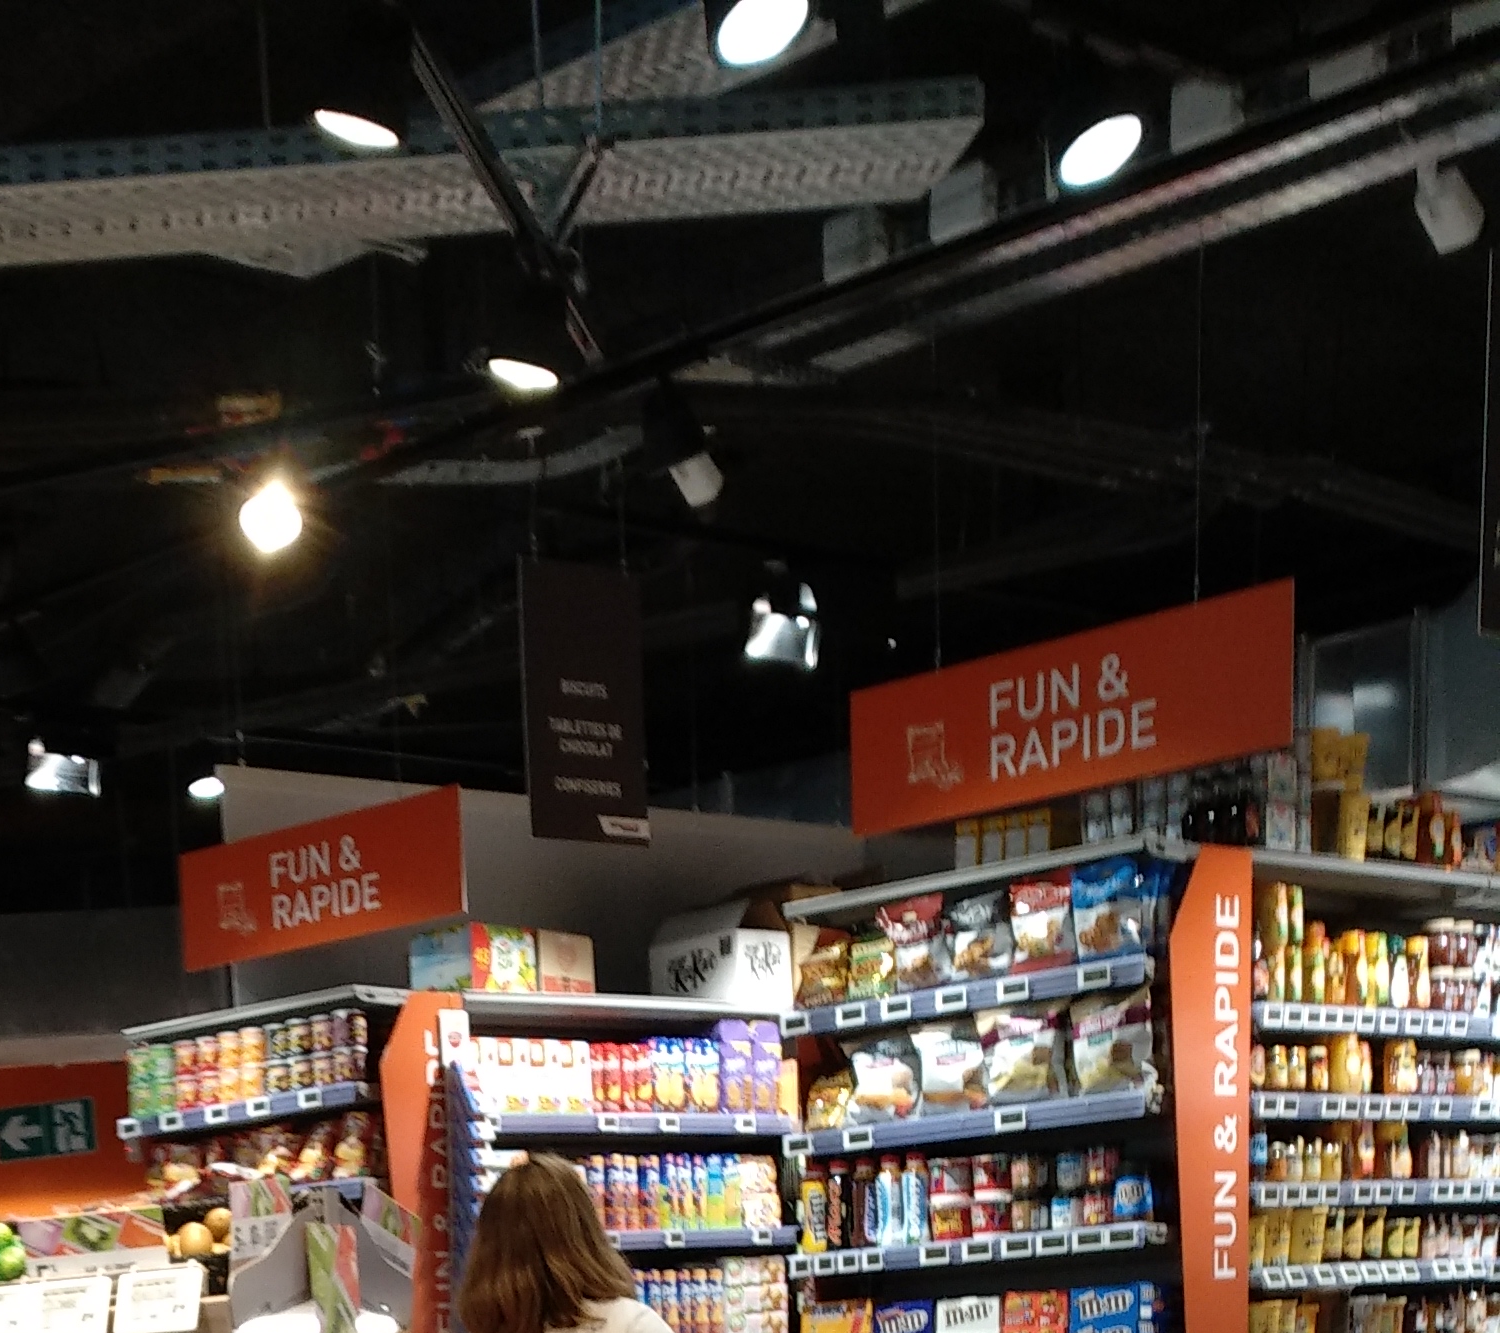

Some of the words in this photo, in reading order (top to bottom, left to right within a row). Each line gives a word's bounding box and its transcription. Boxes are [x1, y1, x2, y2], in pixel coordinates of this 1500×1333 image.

[988, 661, 1081, 729] FUN
[1096, 652, 1129, 701] &
[989, 697, 1158, 782] RAPIDE
[267, 839, 332, 889] FUN
[337, 833, 362, 873] &
[270, 870, 383, 931] RAPIDE
[1213, 893, 1241, 1098] RAPIDE
[1213, 1114, 1239, 1155] &
[1213, 1169, 1238, 1281] FUN
